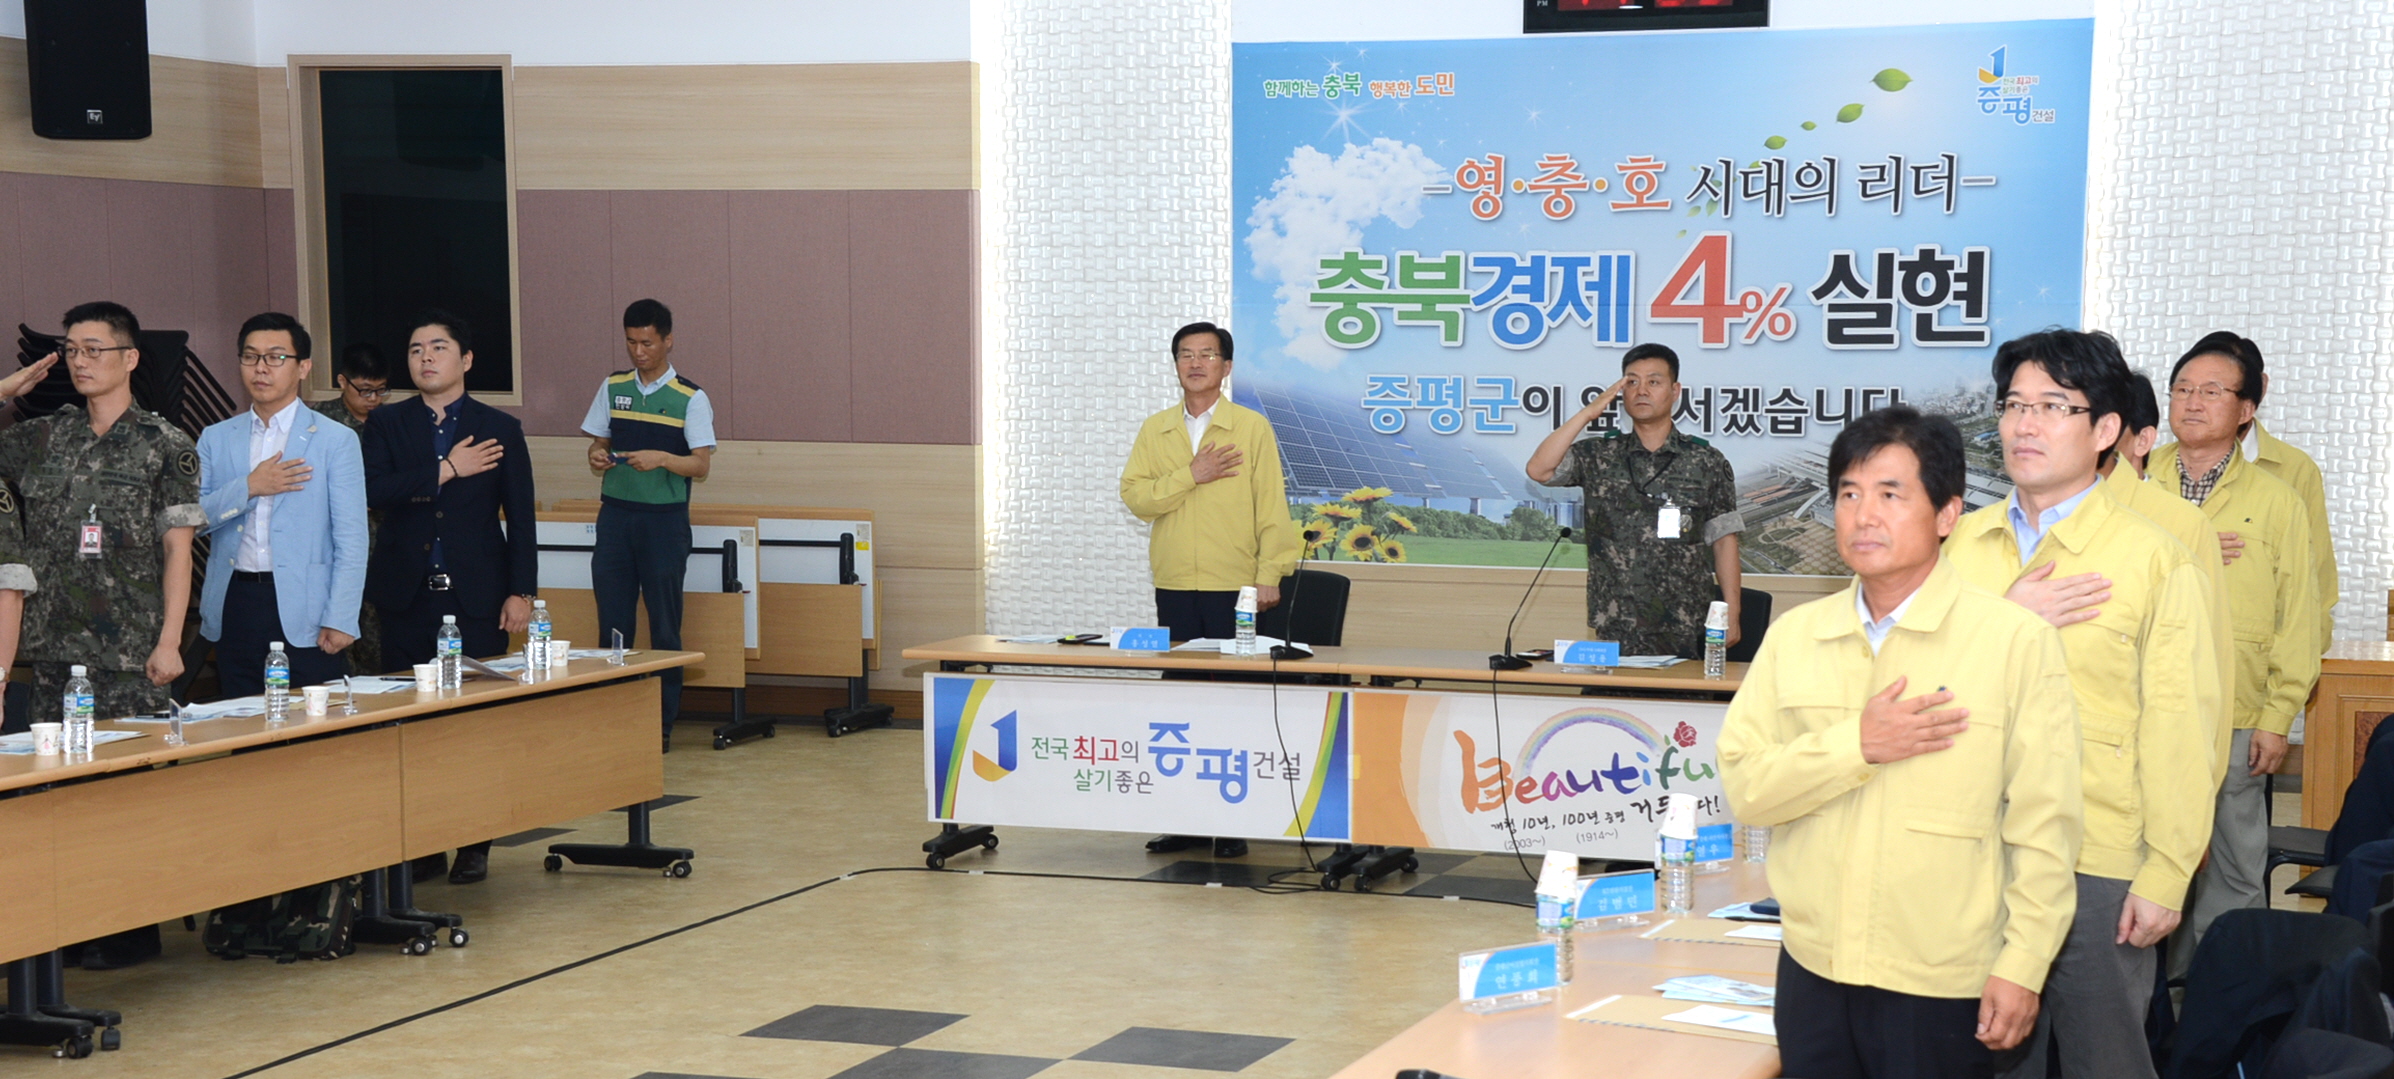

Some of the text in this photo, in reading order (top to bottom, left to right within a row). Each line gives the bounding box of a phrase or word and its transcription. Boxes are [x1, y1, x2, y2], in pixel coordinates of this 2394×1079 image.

[1264, 73, 1454, 98] 함께하는 충북 행복한 도민
[1686, 154, 1837, 217] 시대의
[1310, 234, 1988, 345] 충북경제 4% 실현
[1362, 375, 1564, 435] 증평군이
[1031, 735, 1140, 766] 전국 최고의
[1253, 750, 1301, 781] 건설
[1073, 768, 1154, 795] 살기좋은
[1453, 730, 1719, 815] Beautifu
[1563, 811, 1600, 826] 100년
[1604, 809, 1626, 824] 증평
